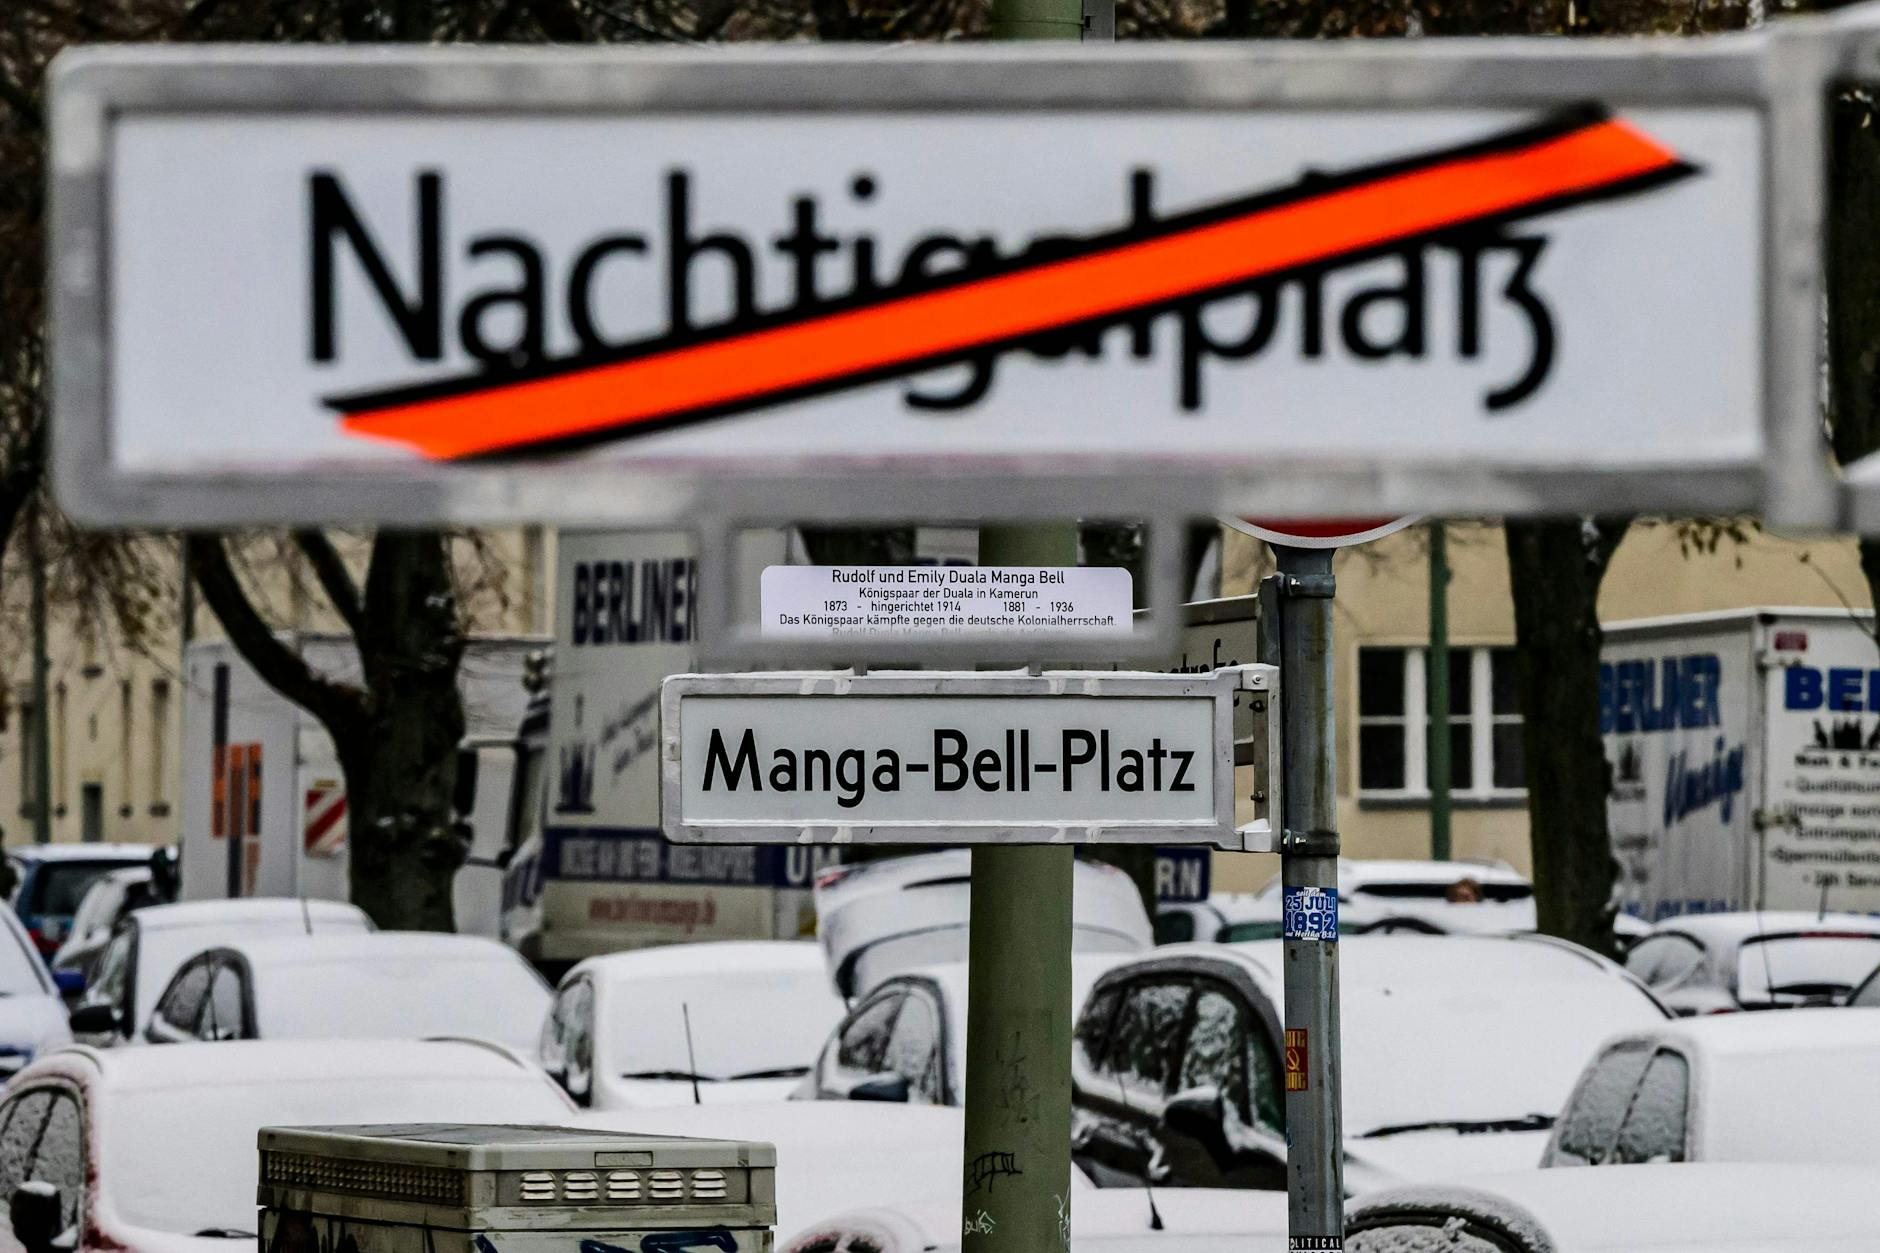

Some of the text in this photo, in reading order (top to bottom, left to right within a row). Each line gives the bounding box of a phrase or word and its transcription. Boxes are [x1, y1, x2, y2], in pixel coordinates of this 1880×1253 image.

[832, 568, 1065, 587] Rudolf und Emily Duala Manga Bell
[859, 587, 1039, 602] Königspaar der Duala in Kamerun
[823, 600, 848, 612] 1873
[870, 600, 934, 615] hingerichtet
[937, 600, 961, 613] 1914
[1003, 601, 1026, 613] 1881
[1050, 601, 1074, 613] 1936
[779, 612, 1117, 629] Das Königspaar kämpfte gegen die deutsche Kolonialherrschaft.
[702, 728, 1196, 808] Manga-Bell-Platz
[1285, 910, 1336, 933] 1892
